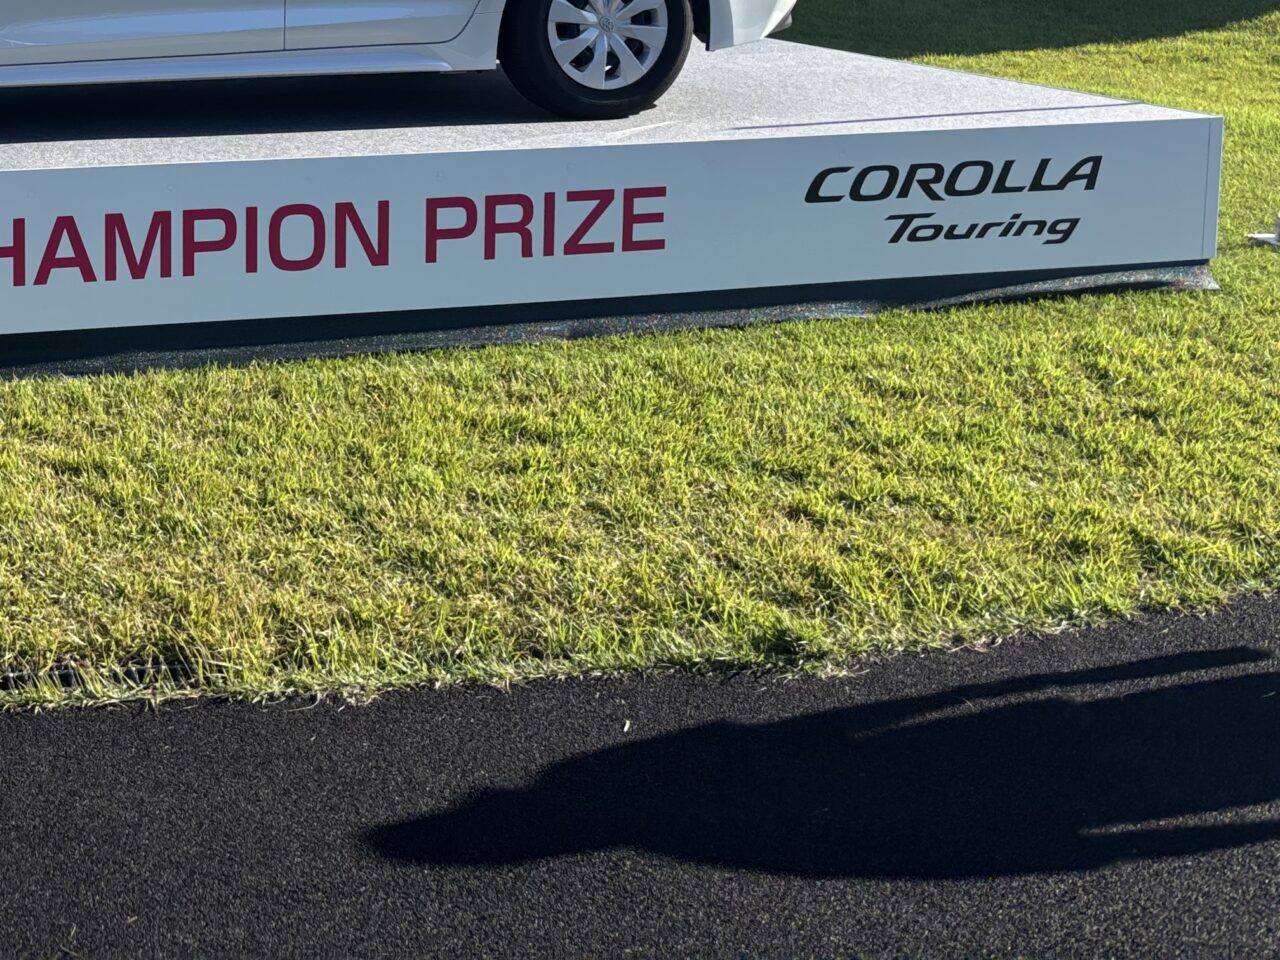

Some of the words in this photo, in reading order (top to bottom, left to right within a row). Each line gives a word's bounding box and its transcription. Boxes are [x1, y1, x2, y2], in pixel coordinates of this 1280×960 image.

[804, 155, 1103, 204] COROLLA
[425, 186, 668, 263] PRIZE
[884, 212, 1081, 245] Touring
